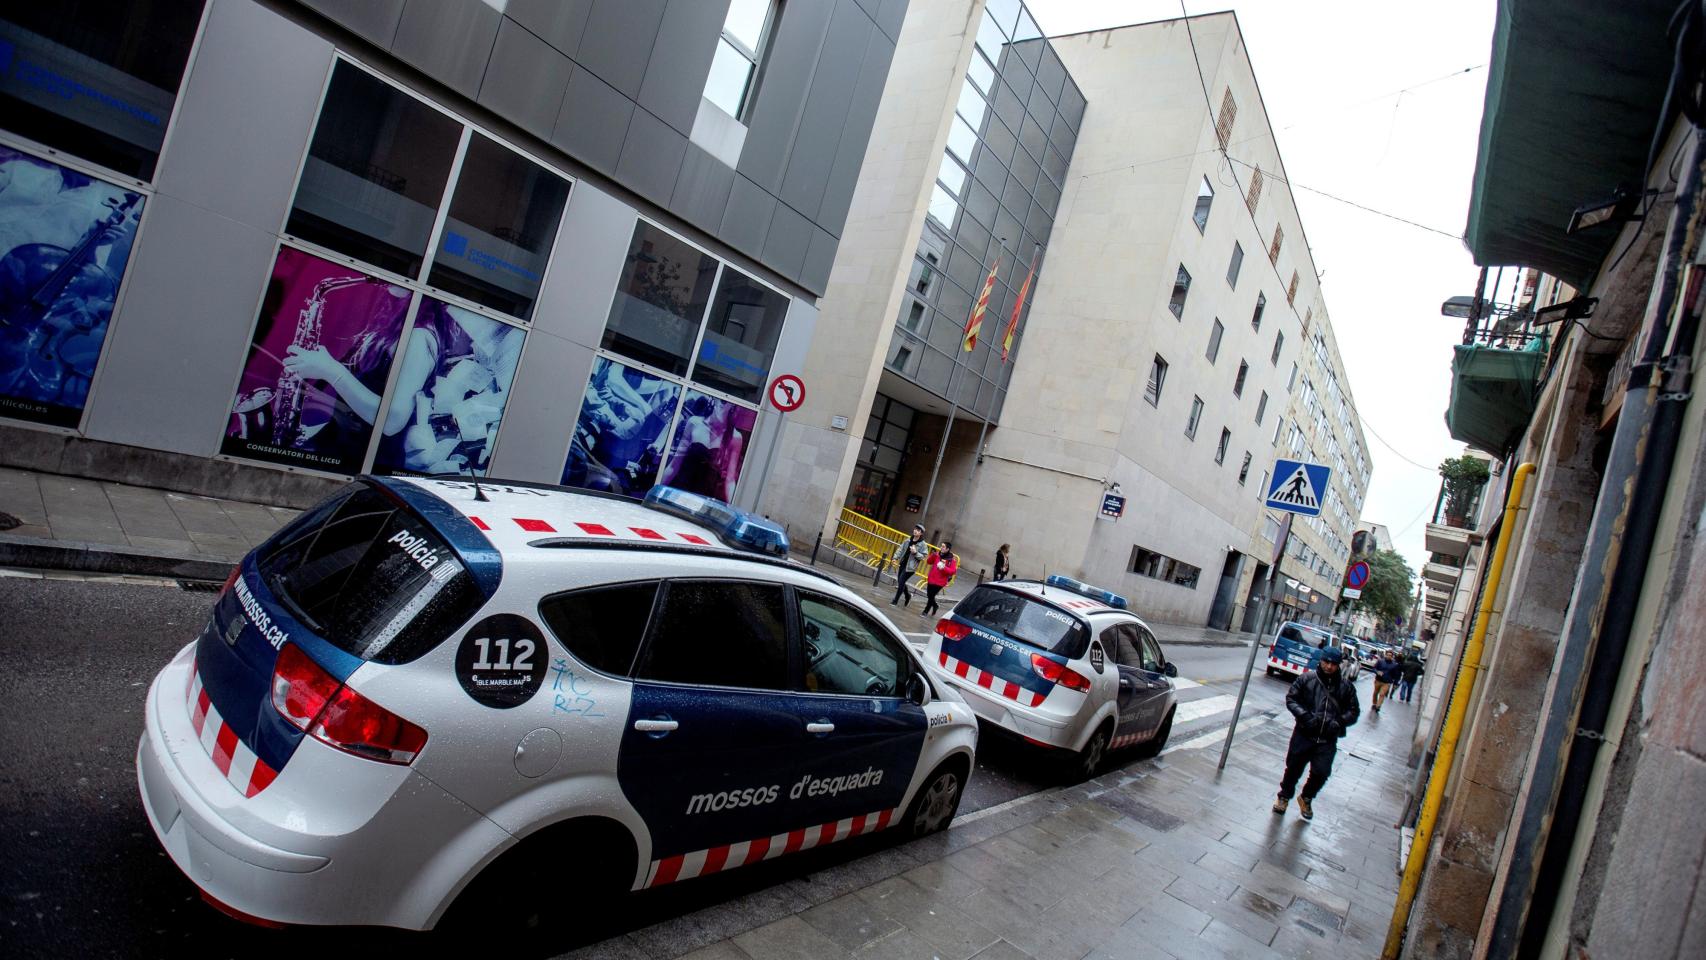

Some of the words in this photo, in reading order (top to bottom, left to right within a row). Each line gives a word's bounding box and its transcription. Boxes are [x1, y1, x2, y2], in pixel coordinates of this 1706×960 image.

[246, 442, 305, 459] CONSERVATORI
[305, 454, 319, 462] DEL
[320, 456, 341, 465] LICEU
[387, 529, 439, 570] policia
[233, 574, 290, 652] www.mossos.cat
[1045, 609, 1075, 627] policia
[472, 637, 536, 671] 112
[1092, 649, 1103, 662] 112
[930, 713, 948, 727] policia
[686, 784, 781, 815] mossos
[790, 765, 885, 800] d'esquadra
